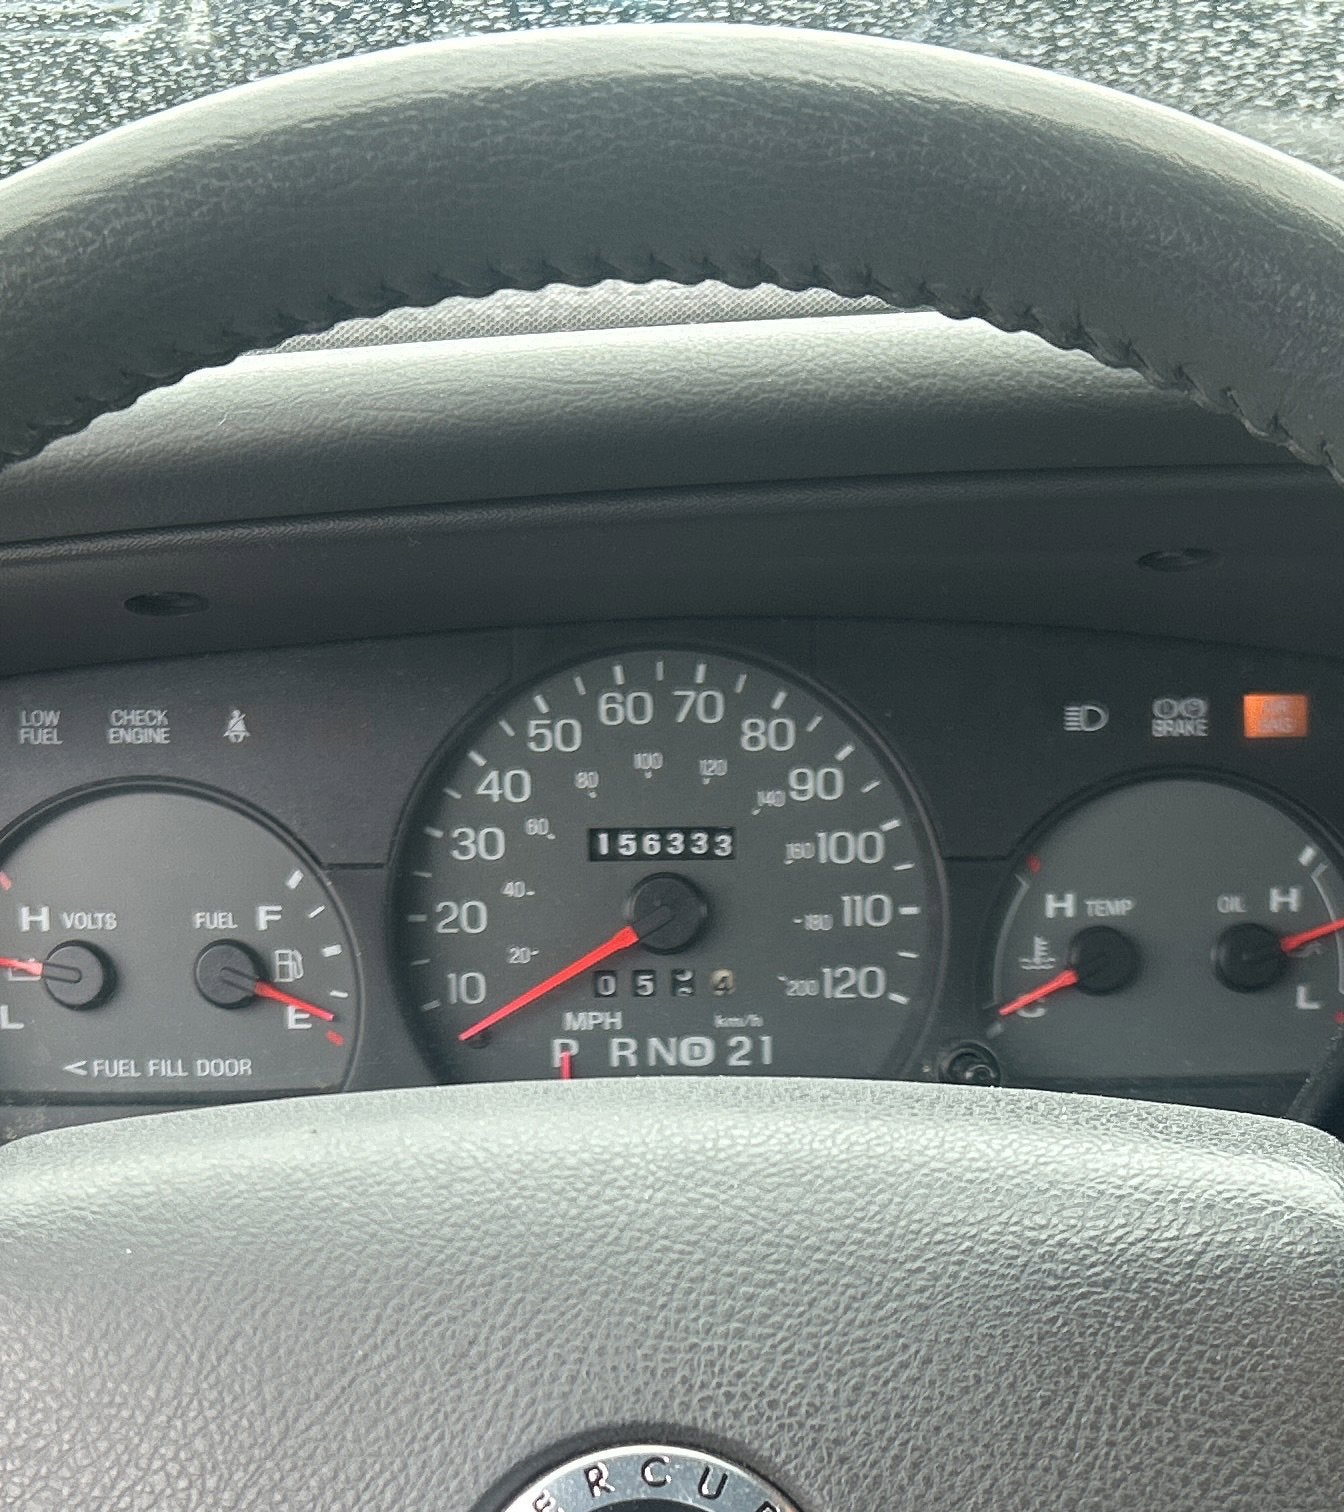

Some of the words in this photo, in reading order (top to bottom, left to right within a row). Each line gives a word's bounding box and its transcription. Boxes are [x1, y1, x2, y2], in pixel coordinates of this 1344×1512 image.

[21, 709, 61, 726] LOW
[110, 709, 169, 727] CHECK
[598, 691, 654, 725] 60
[673, 690, 725, 724] 70
[18, 727, 62, 745] FUEL
[106, 727, 171, 745] ENGINE
[527, 718, 582, 752] 50
[741, 718, 796, 751] 80
[1152, 719, 1209, 738] BRAKE
[633, 752, 663, 771] 100
[699, 758, 728, 777] 120
[476, 768, 532, 803] 40
[788, 767, 844, 801] 90
[451, 826, 505, 861] 30
[597, 832, 734, 857] 156333
[816, 830, 885, 865] 100
[501, 881, 526, 898] 40
[1216, 896, 1247, 914] OIL
[1268, 887, 1301, 913] H
[19, 906, 51, 932] H
[62, 912, 118, 931] VOLTS
[193, 912, 238, 931] FUEL
[258, 905, 283, 931] F
[435, 901, 488, 934] 20
[841, 895, 892, 927] 110
[1044, 893, 1076, 919] H
[1084, 899, 1137, 917] TEMP
[506, 947, 531, 964] 20
[447, 972, 487, 1005] 10
[785, 979, 818, 998] 200
[821, 966, 887, 999] 120
[1296, 985, 1320, 1009] L
[287, 1005, 313, 1030] E
[562, 1011, 623, 1032] MPH
[713, 1012, 765, 1029] km/h
[551, 1037, 579, 1067] P
[609, 1037, 638, 1068] R
[647, 1037, 678, 1067] N
[727, 1036, 753, 1067] 2
[759, 1035, 773, 1066] 1
[91, 1059, 142, 1078] FUEL
[148, 1059, 188, 1078] FILL
[196, 1058, 253, 1078] DOOR
